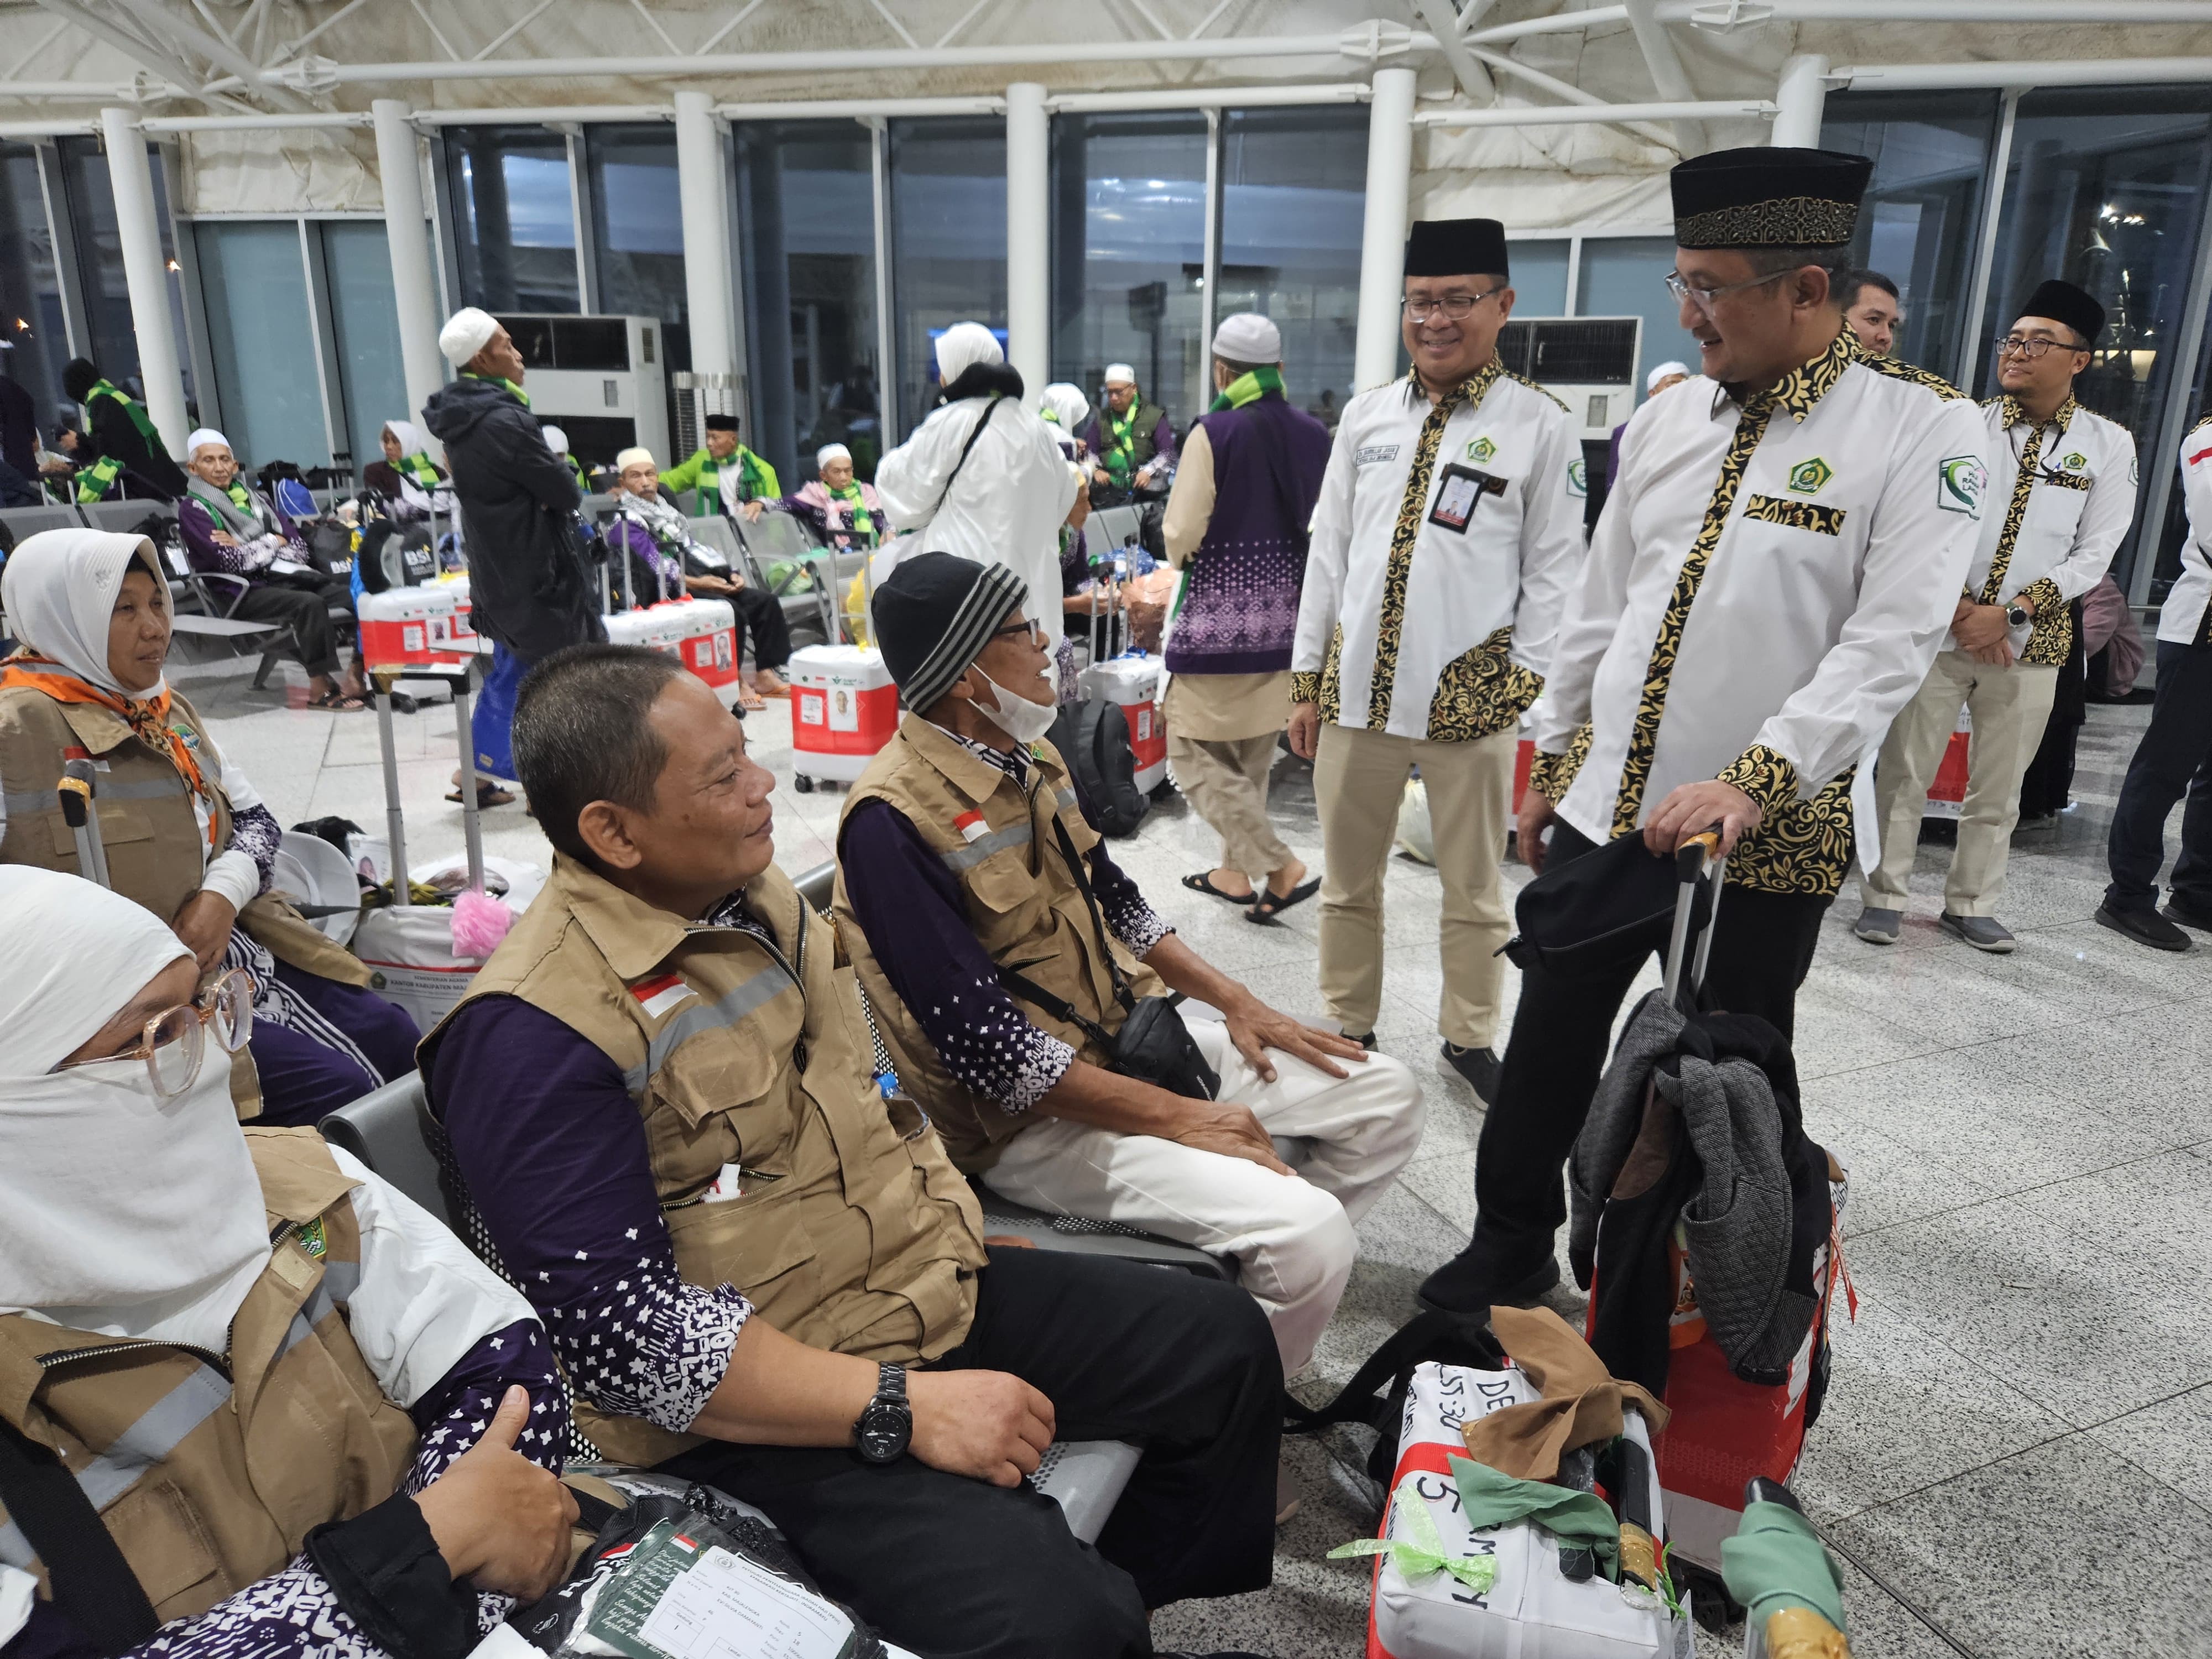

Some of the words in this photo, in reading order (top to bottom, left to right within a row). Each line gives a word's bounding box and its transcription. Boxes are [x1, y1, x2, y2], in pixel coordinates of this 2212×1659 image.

[415, 982, 452, 990] KABUPATEN
[1416, 1477, 1461, 1513] 5
[637, 1574, 660, 1589] Selamat
[614, 1599, 637, 1615] Semoga
[801, 1601, 828, 1621] INDRAMAYU
[676, 1612, 692, 1625] Gedung
